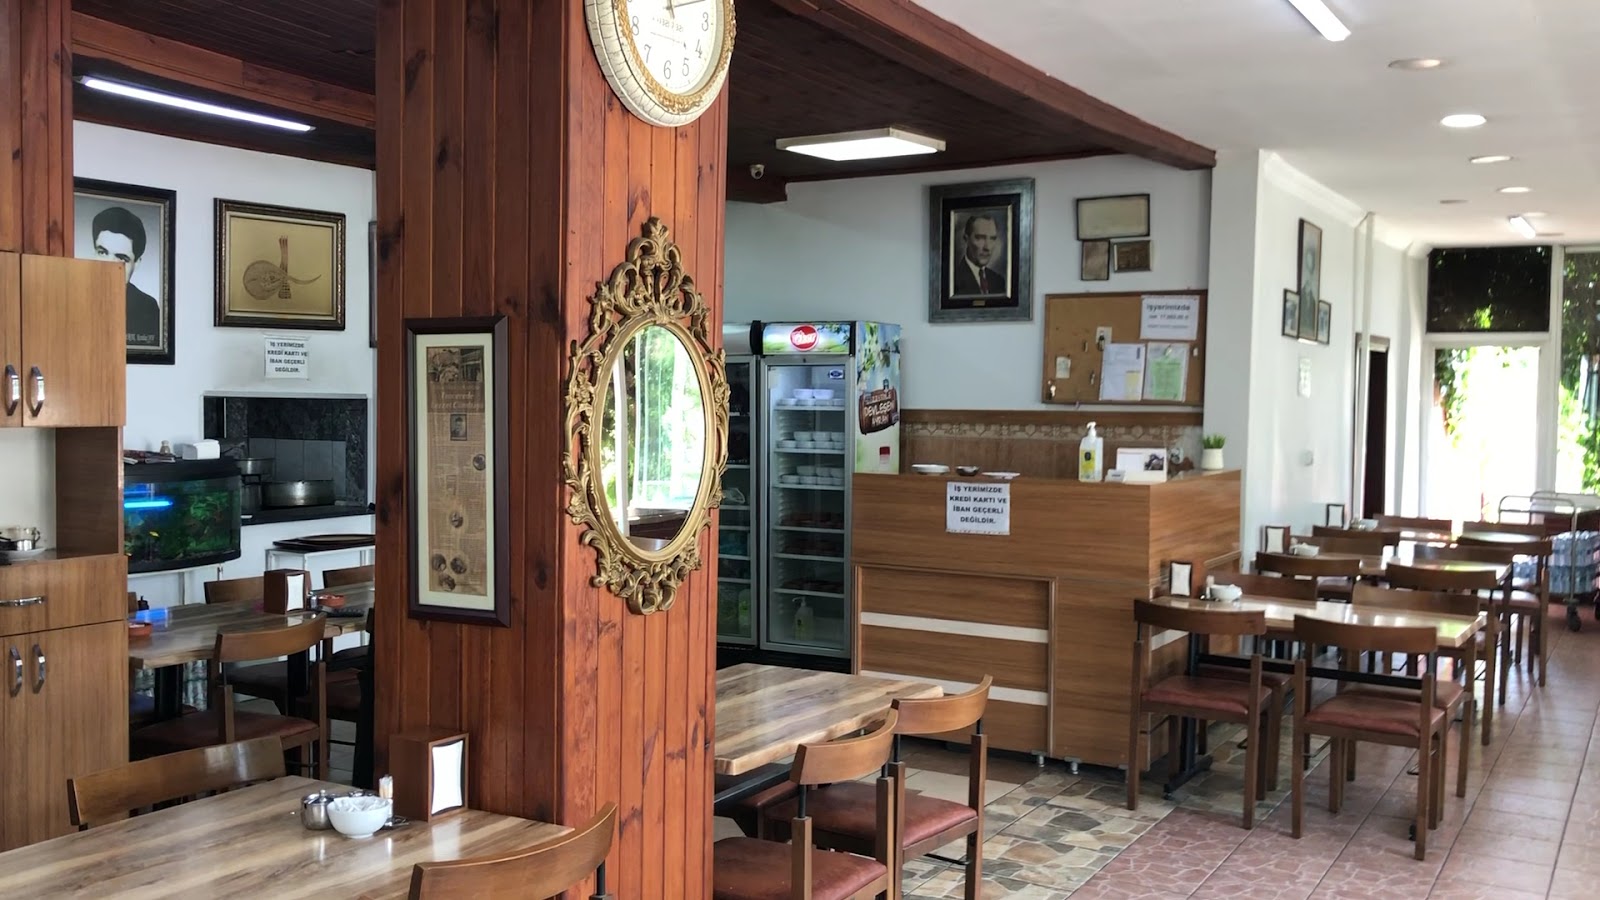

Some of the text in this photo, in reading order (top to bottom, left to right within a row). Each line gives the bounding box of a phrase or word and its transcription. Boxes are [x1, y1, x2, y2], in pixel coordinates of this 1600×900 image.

[632, 15, 640, 36] 8
[701, 11, 709, 32] 3
[643, 43, 652, 64] 7
[695, 38, 703, 59] 4
[663, 60, 672, 80] 6
[682, 57, 690, 77] 5
[954, 484, 1003, 493] İŞ YERİMİZDE
[973, 496, 996, 504] KARTI
[960, 516, 997, 525] DEĞİLDİR.
[972, 506, 1004, 515] GEÇERLİ
